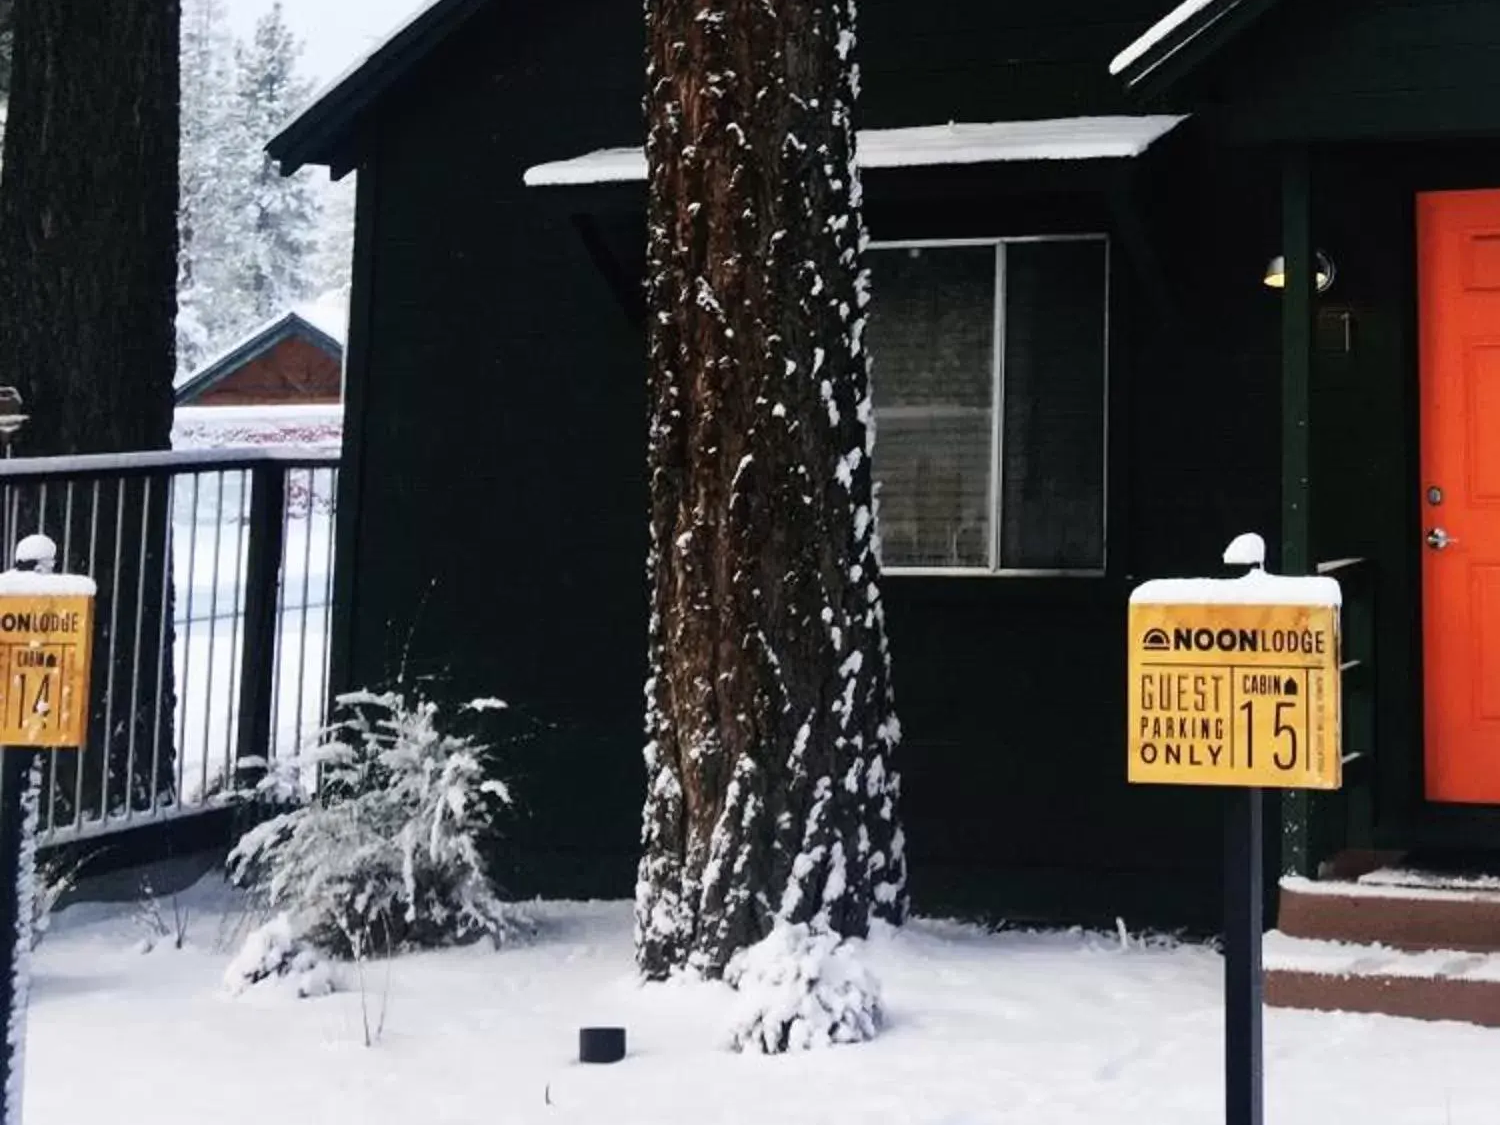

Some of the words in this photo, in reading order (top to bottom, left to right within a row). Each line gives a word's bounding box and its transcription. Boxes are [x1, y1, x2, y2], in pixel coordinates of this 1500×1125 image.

[1, 611, 79, 634] ONLODGE
[1141, 674, 1223, 712] GUEST
[1242, 674, 1281, 696] CABIN
[17, 673, 50, 730] 14
[1140, 716, 1224, 741] PARKING
[1240, 700, 1297, 771] 15
[1140, 743, 1223, 767] ONLY
